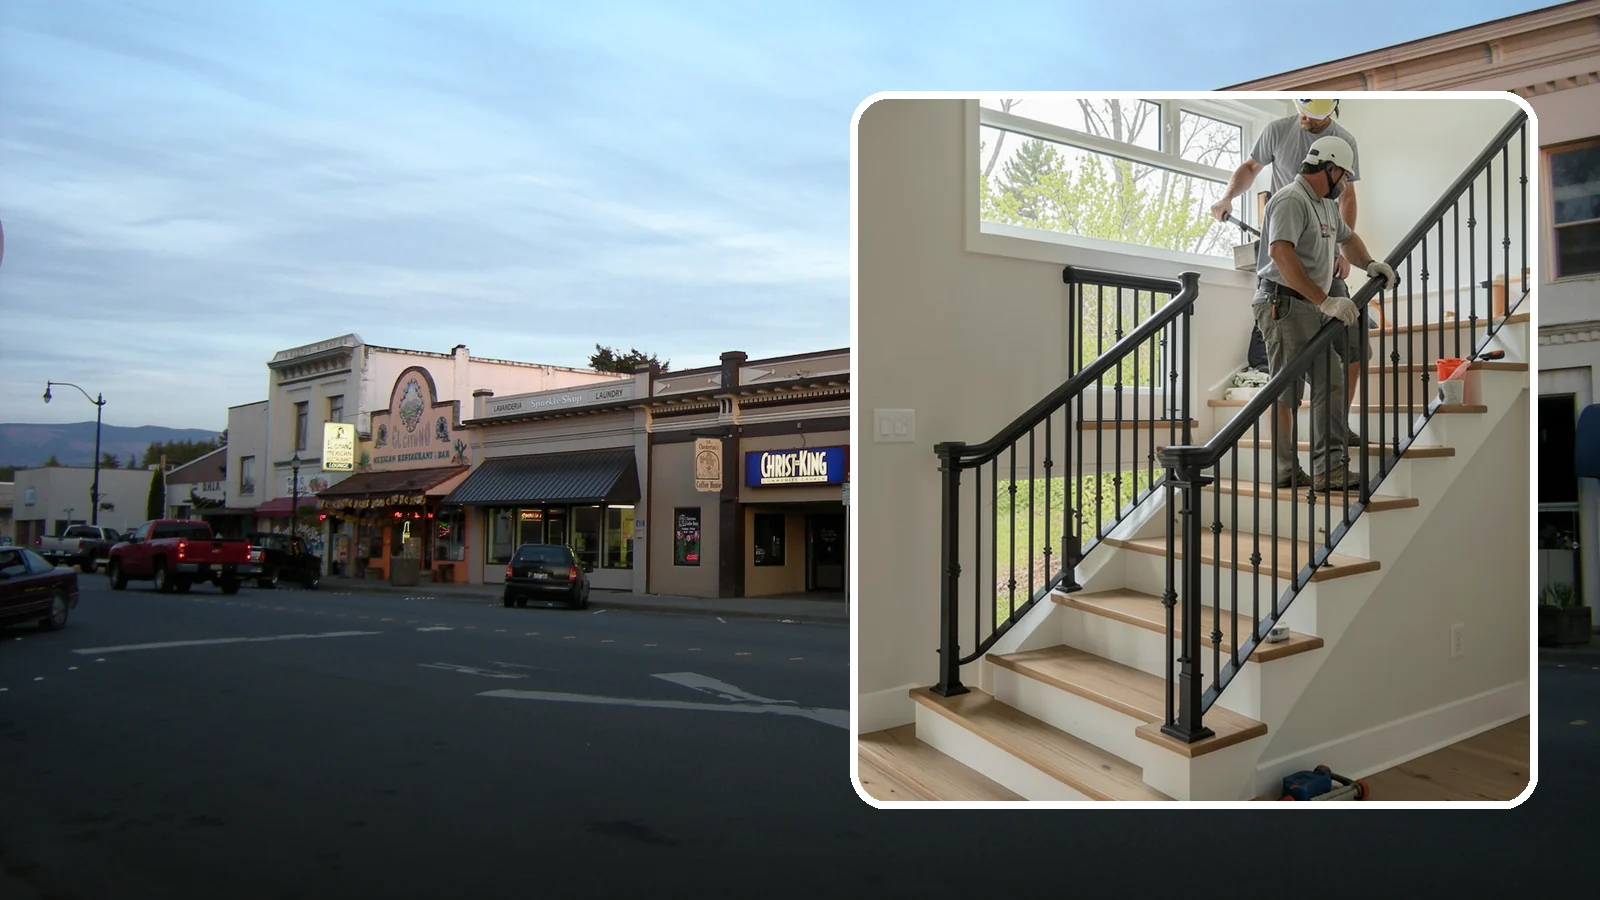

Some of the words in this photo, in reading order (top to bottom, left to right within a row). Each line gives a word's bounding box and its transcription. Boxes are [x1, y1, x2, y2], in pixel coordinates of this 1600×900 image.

[493, 402, 522, 413] LAVANDERIA
[530, 398, 560, 409] Sparkle
[562, 394, 583, 405] Shop
[595, 388, 623, 400] LAUNDRY
[373, 454, 396, 464] MEXICAN
[397, 451, 433, 462] RESTAURANT
[438, 450, 450, 459] BAR
[761, 452, 797, 478] CHRIST
[799, 450, 827, 476] KING
